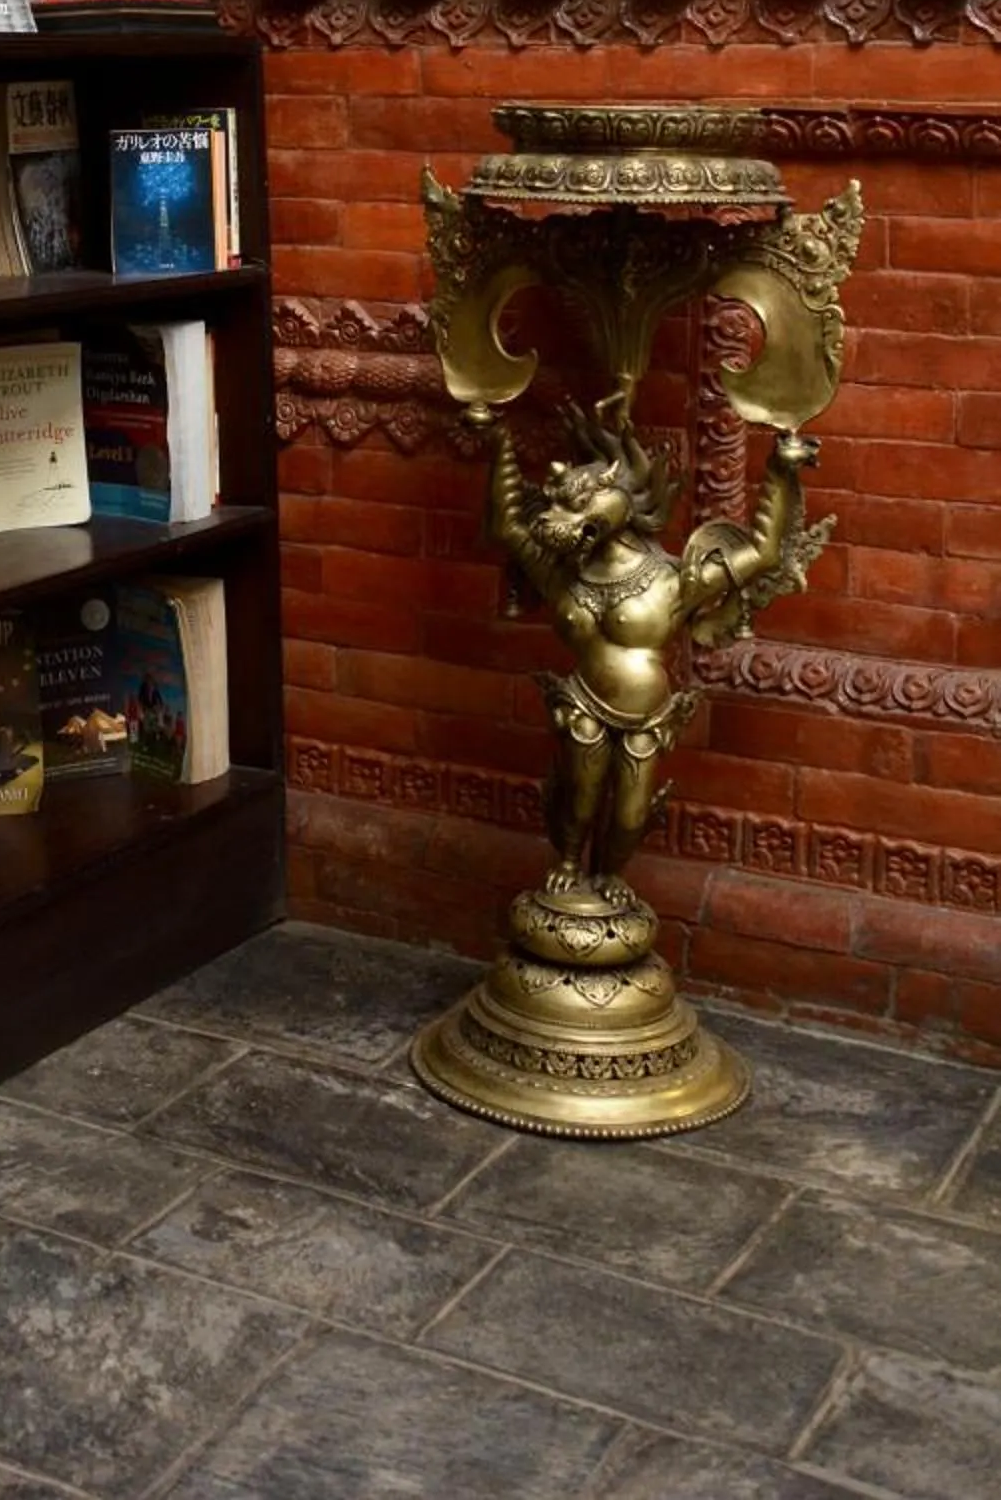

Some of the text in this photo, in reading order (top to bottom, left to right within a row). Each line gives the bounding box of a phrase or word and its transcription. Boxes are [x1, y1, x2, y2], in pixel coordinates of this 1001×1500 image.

[115, 131, 210, 152] ガリレオの苦悩
[36, 644, 104, 668] STATION
[40, 664, 102, 688] ELEVEN
